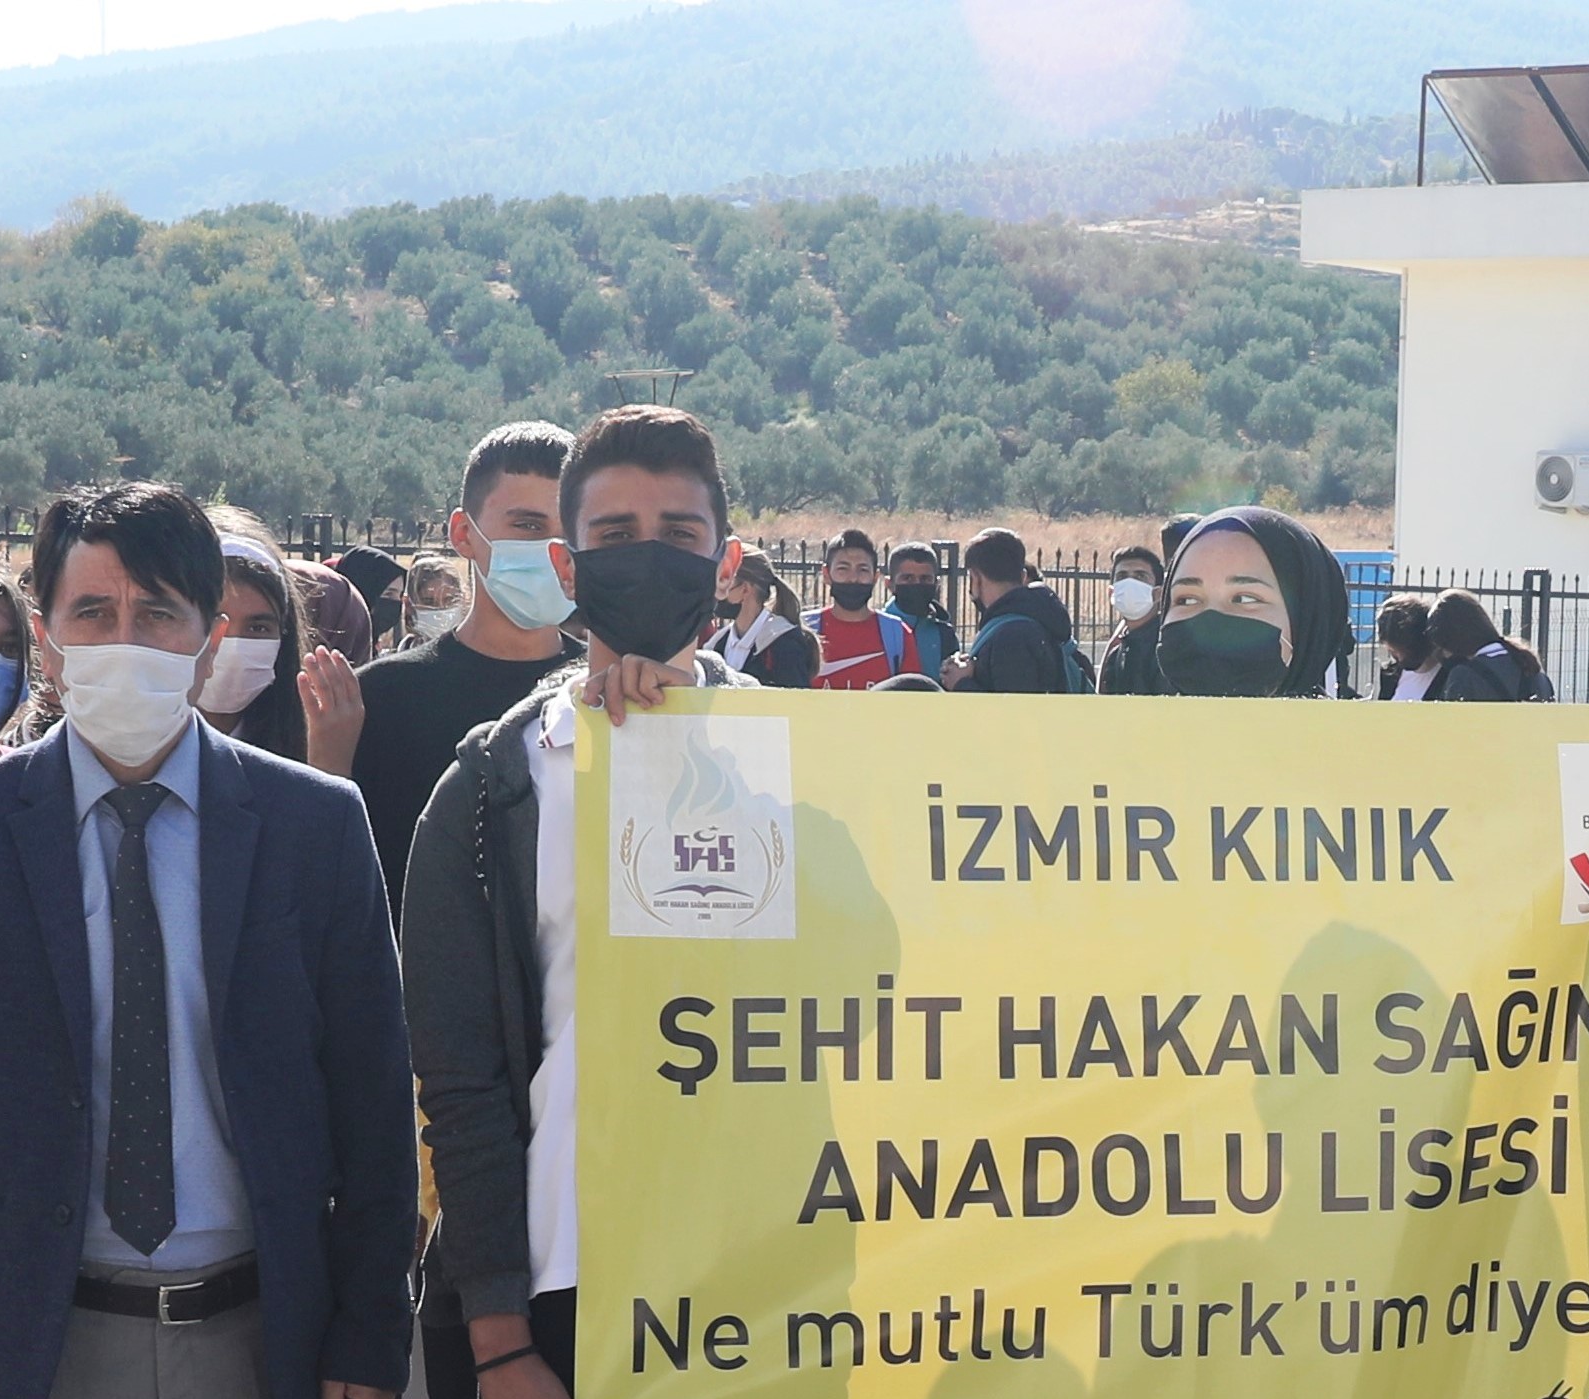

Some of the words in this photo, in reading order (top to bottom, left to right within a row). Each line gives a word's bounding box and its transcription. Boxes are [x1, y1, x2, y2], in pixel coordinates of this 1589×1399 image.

[927, 782, 1178, 883] İZMİR
[1211, 805, 1454, 883] KINIK
[656, 972, 963, 1097] ŞEHİT
[997, 992, 1341, 1082] HAKAN
[796, 1131, 1284, 1226] ANADOLU
[1319, 1094, 1570, 1213] LİSESİ
[632, 1296, 750, 1375] Ne
[786, 1288, 1047, 1370] mutlu
[1079, 1280, 1430, 1360] Türk'üm
